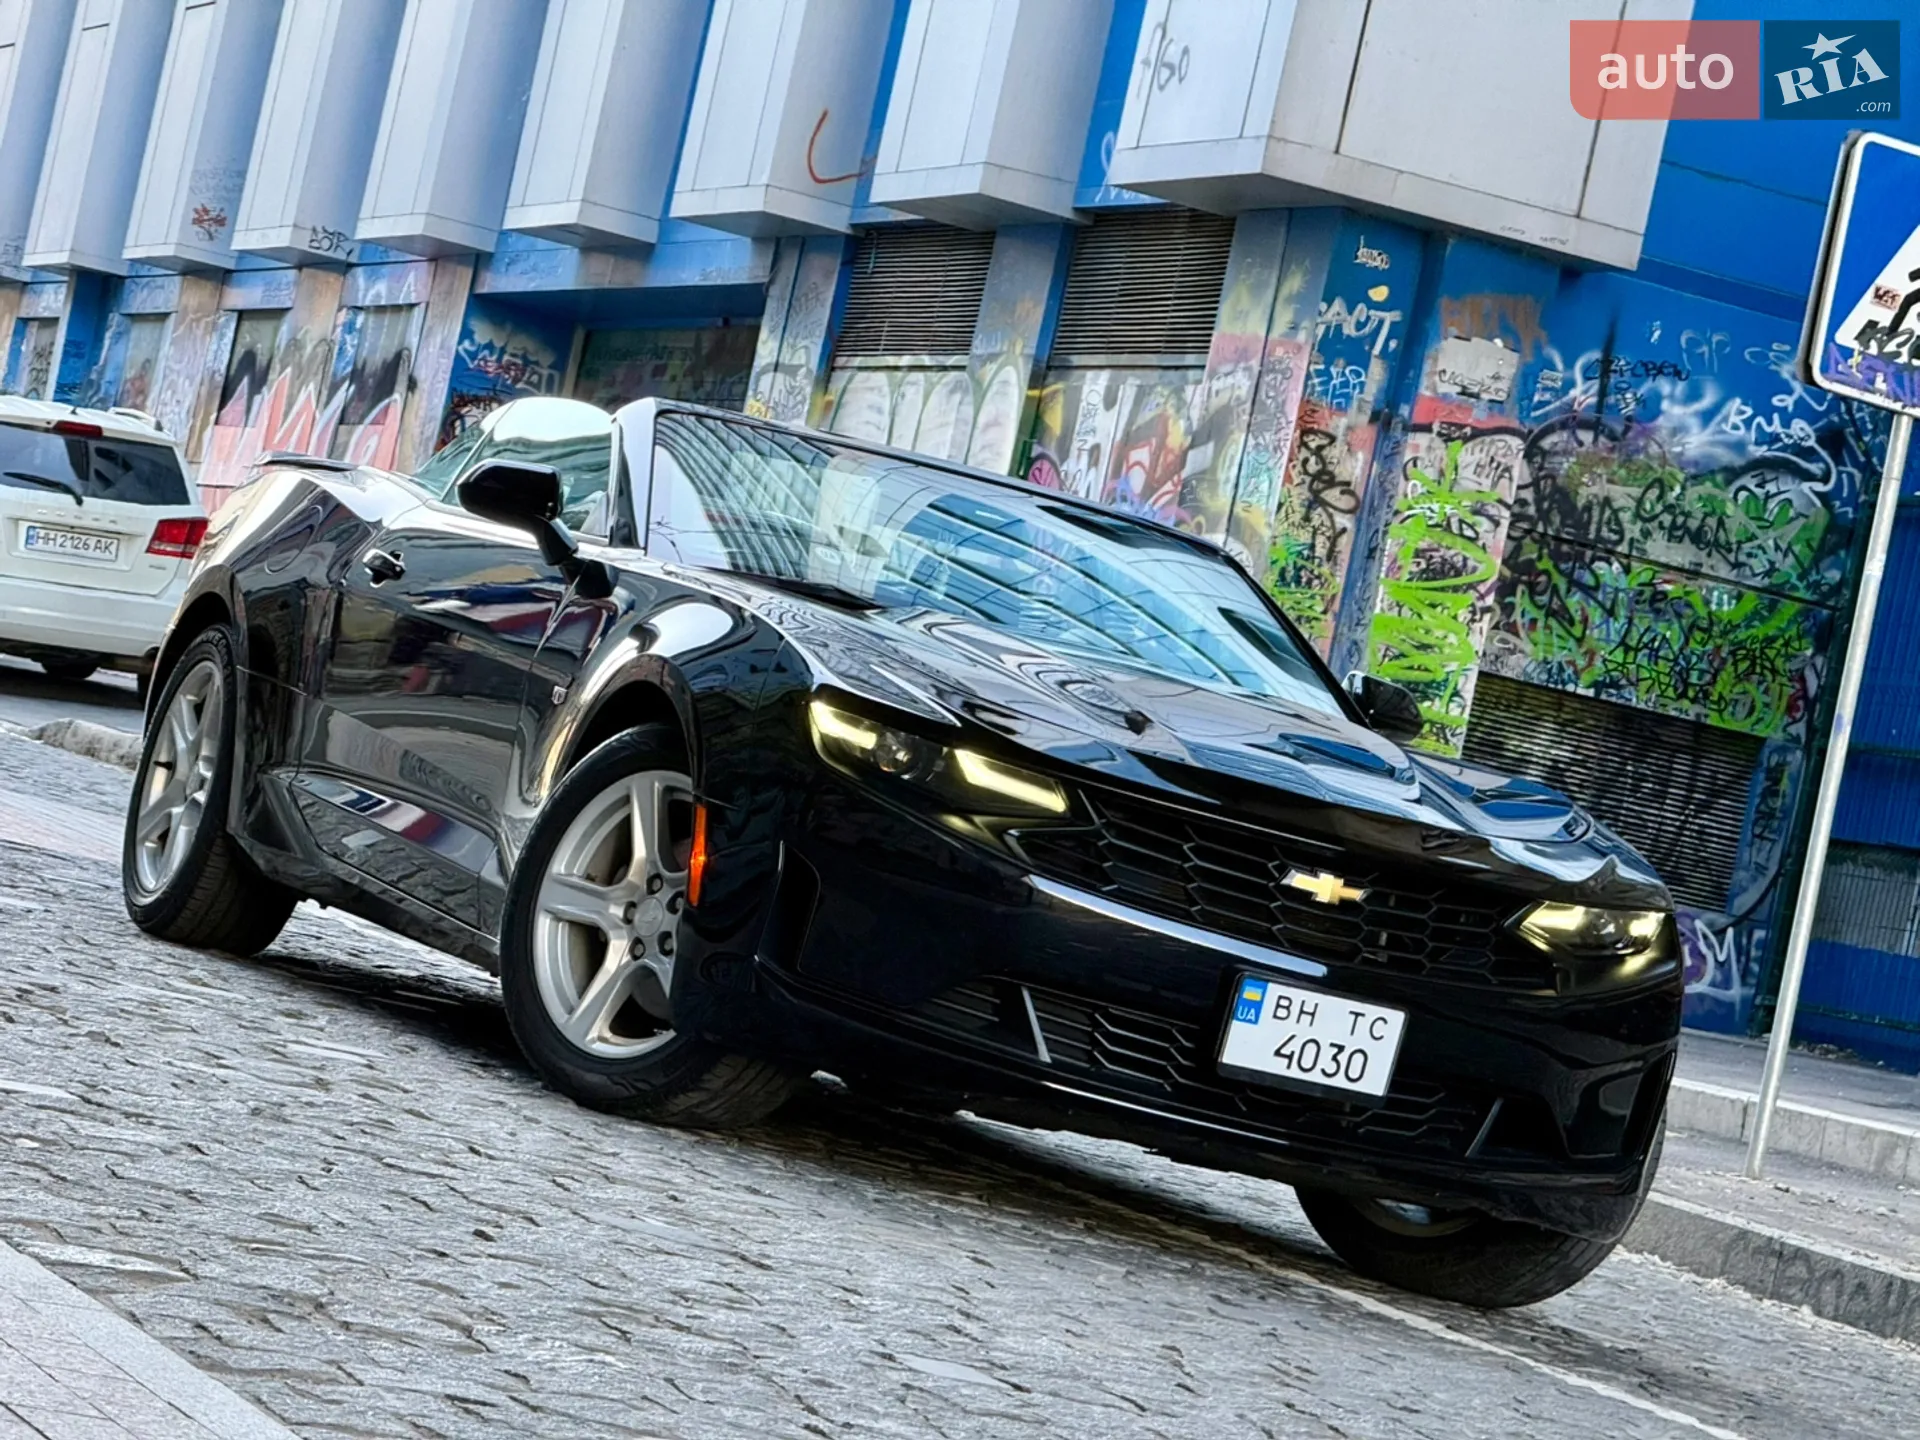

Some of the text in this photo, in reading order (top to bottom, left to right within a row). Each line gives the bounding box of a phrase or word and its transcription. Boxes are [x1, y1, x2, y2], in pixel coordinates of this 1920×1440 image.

[35, 531, 114, 555] HH 2126 AK
[1237, 1005, 1256, 1022] UA
[1271, 994, 1388, 1041] BH TC
[1273, 1034, 1369, 1083] 4030
